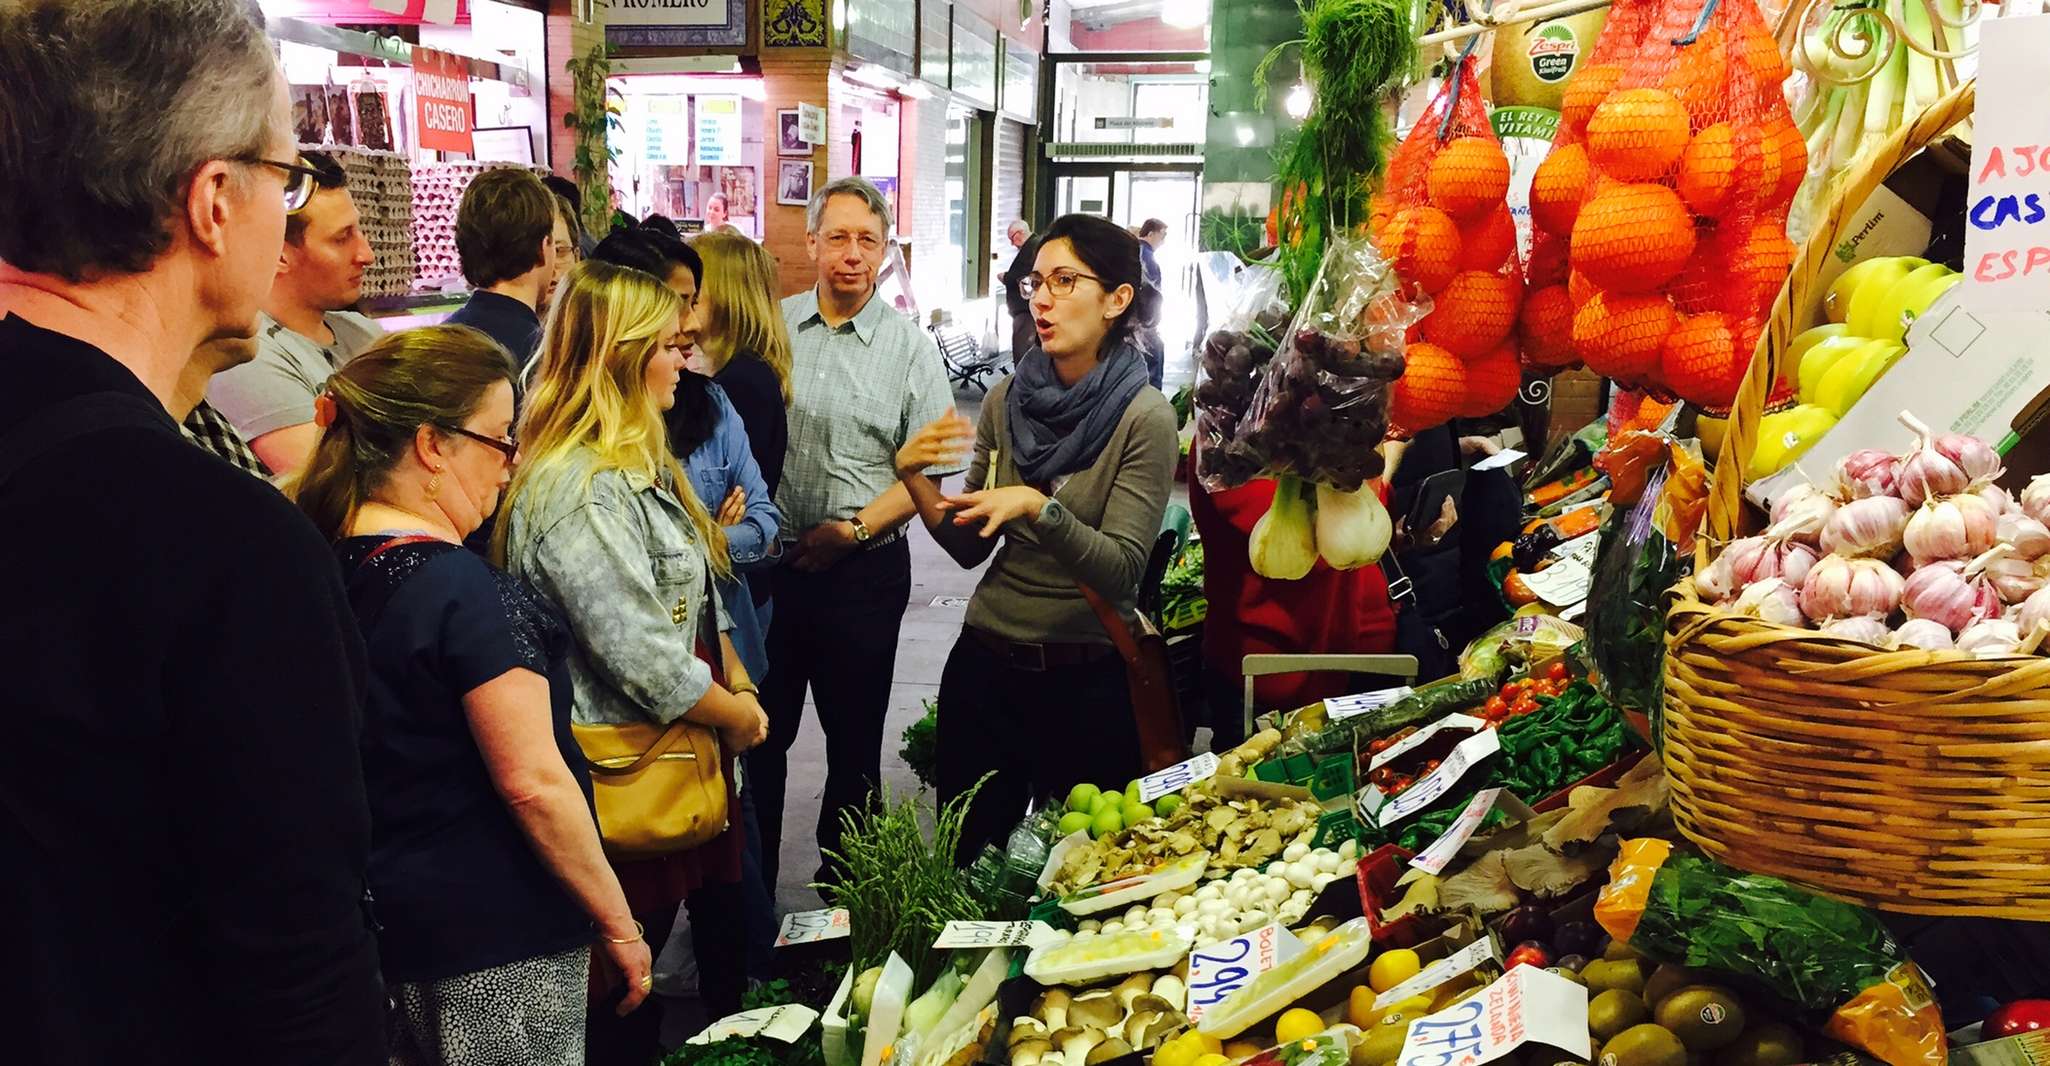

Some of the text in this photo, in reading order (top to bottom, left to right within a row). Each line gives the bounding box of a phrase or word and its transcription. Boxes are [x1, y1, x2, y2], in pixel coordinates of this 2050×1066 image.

[1529, 38, 1578, 55] Zespri
[1539, 57, 1567, 67] Green
[416, 72, 469, 103] CHICHARRÓN
[424, 101, 466, 133] CASERO
[1499, 122, 1554, 139] VITAMI
[1500, 111, 1513, 122] EL
[1519, 112, 1544, 122] REY
[1970, 193, 2050, 230] CAS
[1851, 211, 1885, 247] Perlim
[1975, 246, 2050, 282] ESP
[1259, 927, 1274, 973] BOLET
